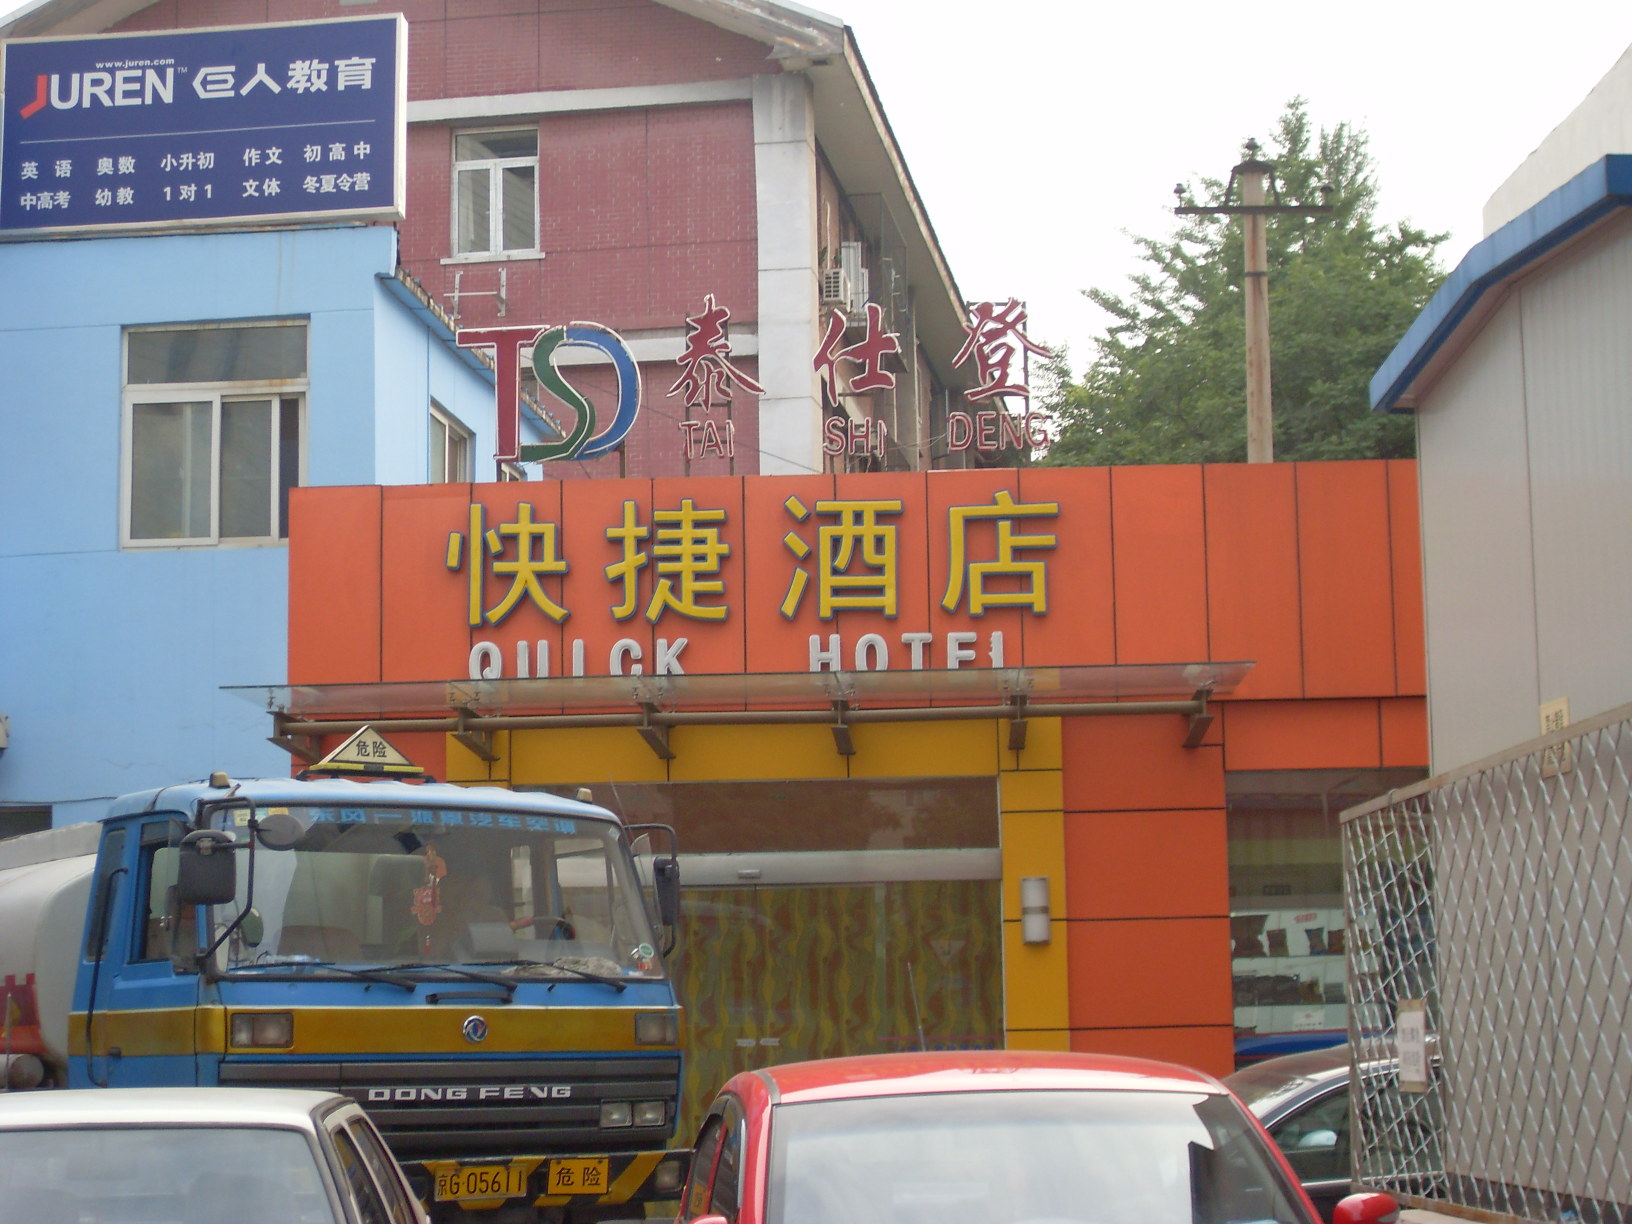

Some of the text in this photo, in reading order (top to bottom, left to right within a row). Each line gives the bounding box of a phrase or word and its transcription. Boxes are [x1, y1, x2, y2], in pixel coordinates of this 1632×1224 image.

[95, 58, 175, 69] www.juren.com
[192, 56, 376, 99] 巨人教育
[19, 67, 175, 119] JUREN
[21, 141, 371, 180] 英语 奥数 小升初 作文 初高中
[20, 191, 71, 211] 中高考
[95, 187, 134, 206] 幼教
[242, 178, 281, 197] 文体
[303, 172, 371, 193] 冬夏令营
[667, 293, 1055, 413] 泰仕登
[680, 410, 1052, 459] TAI SHI DENG
[446, 489, 1060, 627] 快捷酒店
[468, 638, 689, 680] QUICK
[355, 740, 388, 758] 危险
[368, 1086, 571, 1101] DONG FENG
[556, 1167, 602, 1187] 危险
